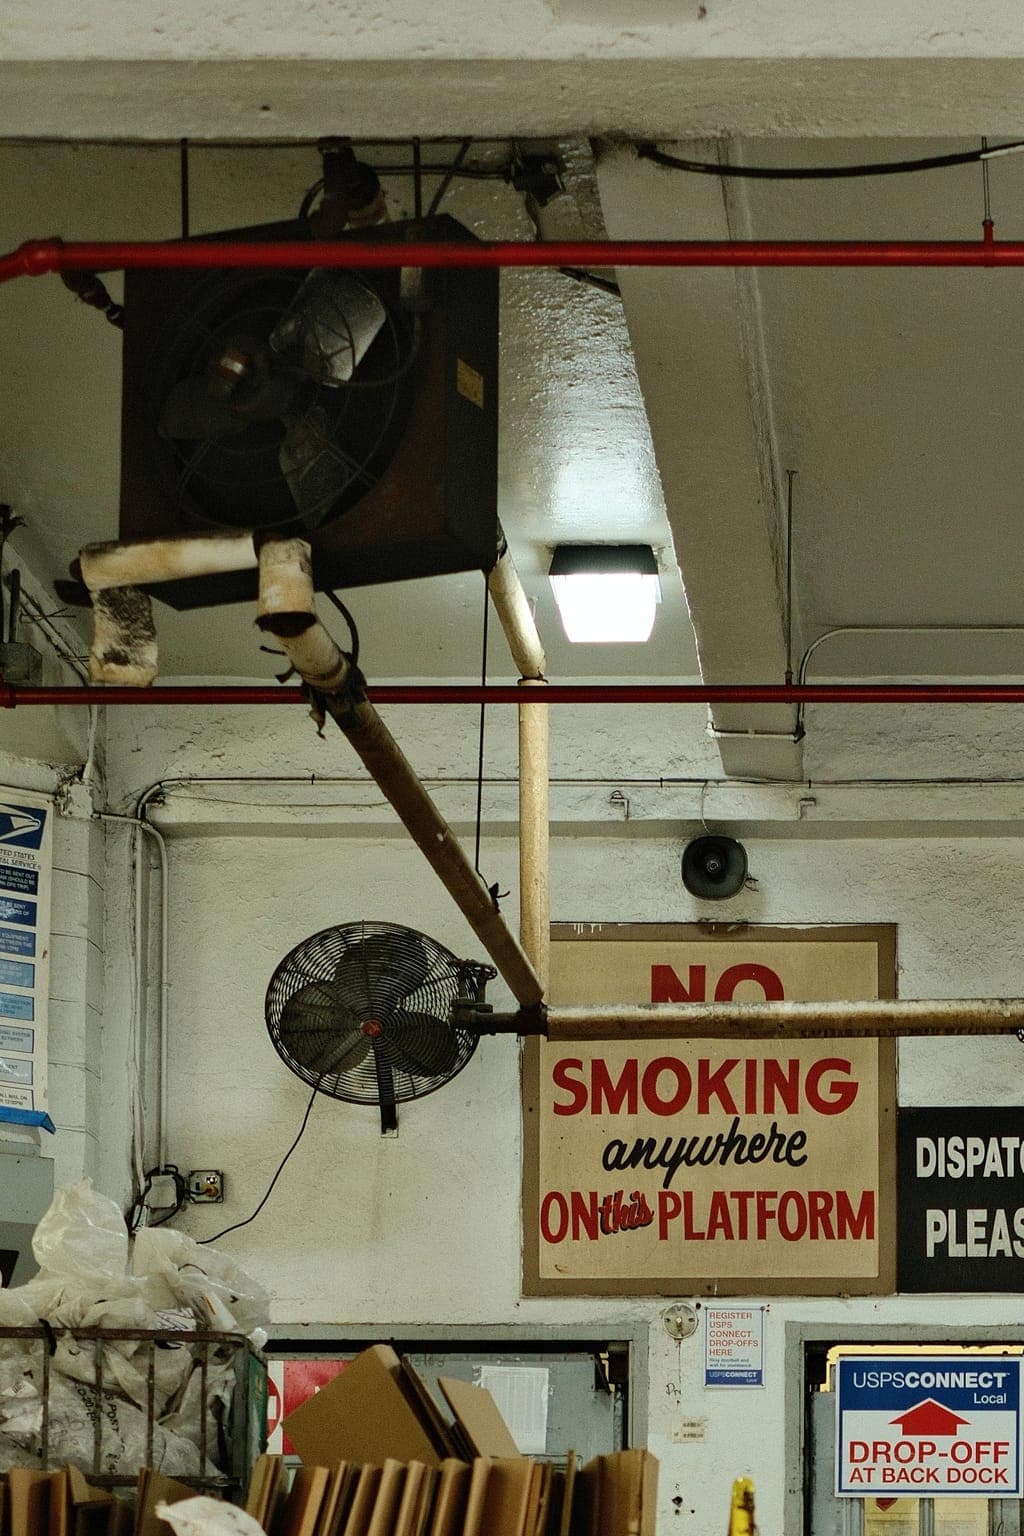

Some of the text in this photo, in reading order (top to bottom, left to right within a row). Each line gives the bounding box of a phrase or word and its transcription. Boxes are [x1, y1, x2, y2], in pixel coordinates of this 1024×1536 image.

[14, 851, 35, 860] STATES
[651, 964, 785, 1001] NO
[552, 1057, 859, 1116] SMOKING
[602, 1117, 808, 1188] anywhere
[541, 1190, 875, 1243] ON this PLATFORM
[709, 1312, 753, 1320] REGISTER
[709, 1321, 733, 1329] USPS
[709, 1330, 752, 1338] CONNECT
[709, 1339, 759, 1347] DROP-OFFS
[709, 1348, 733, 1356] HERE
[973, 1392, 1007, 1404] Local
[849, 1441, 1010, 1464] DROP-OFF
[849, 1467, 1009, 1484] AT BACK DOCK
